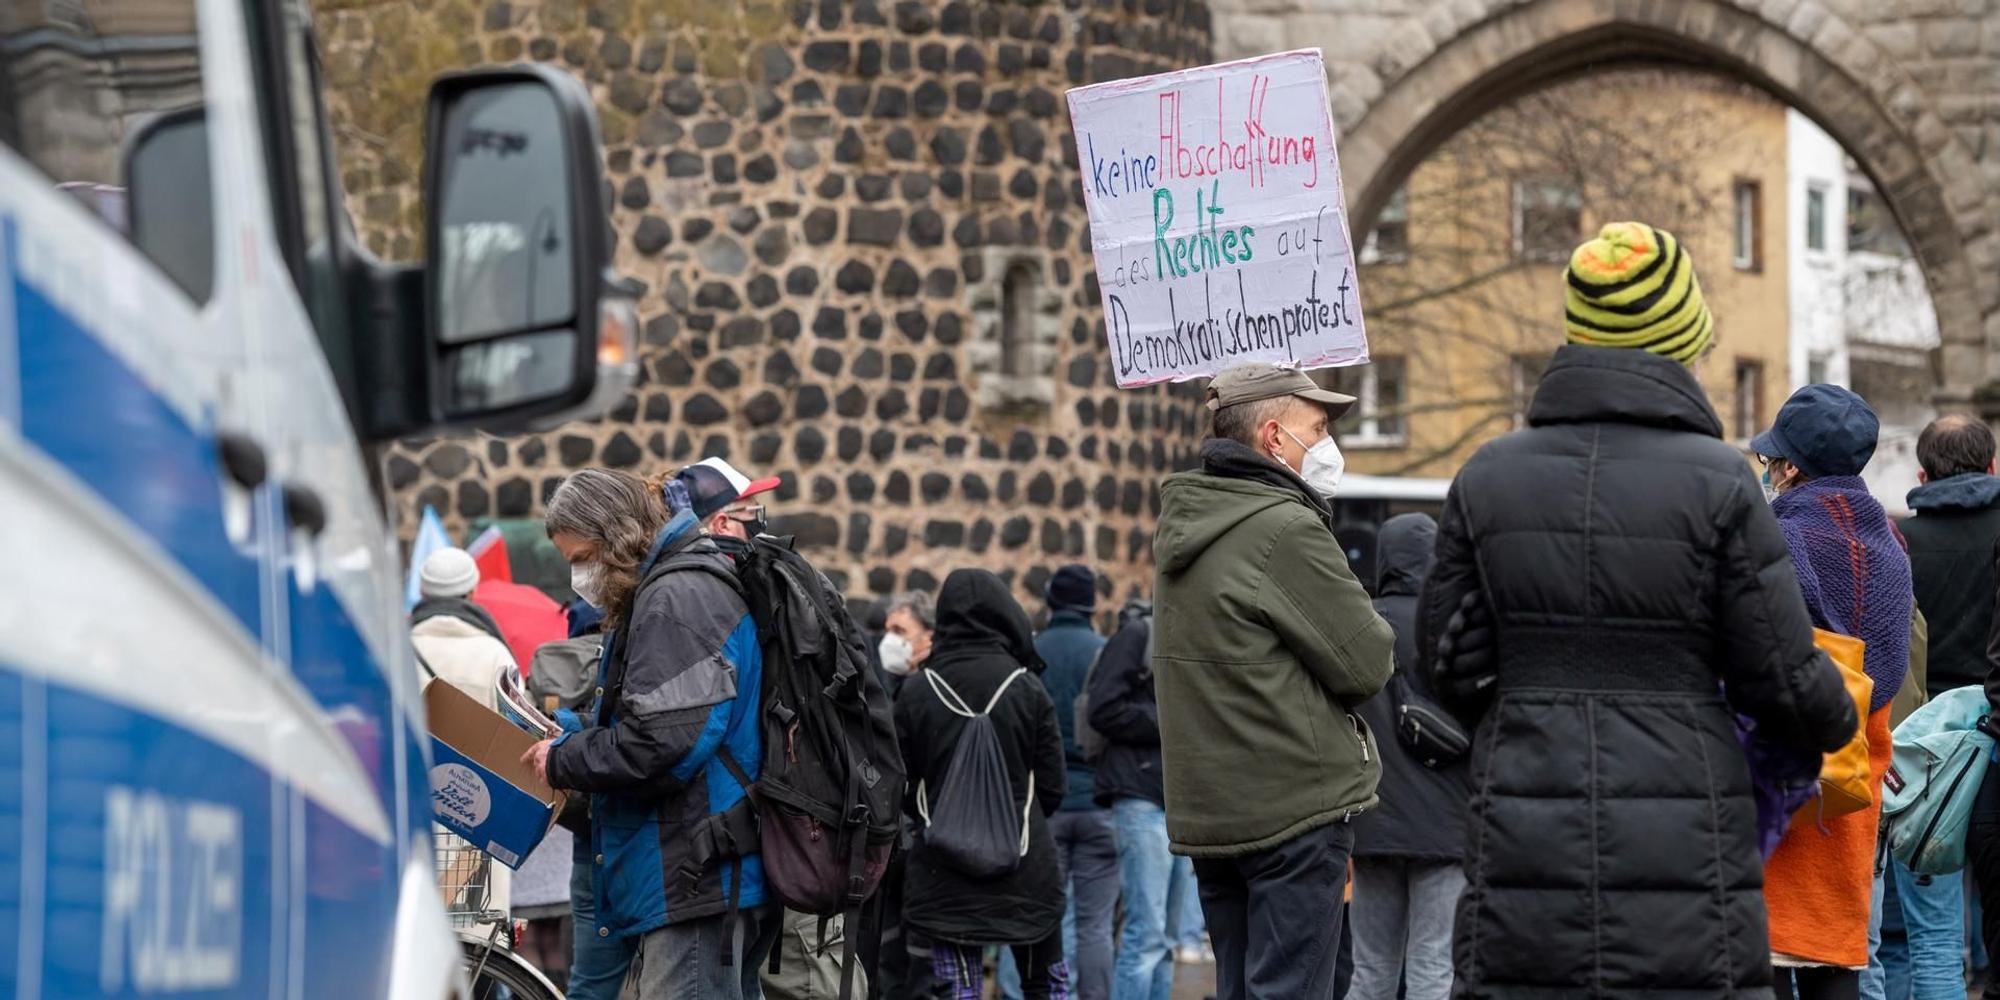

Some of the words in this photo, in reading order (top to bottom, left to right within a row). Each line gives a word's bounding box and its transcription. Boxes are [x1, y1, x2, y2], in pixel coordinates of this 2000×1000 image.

[1088, 132, 1158, 198] keine
[1159, 74, 1317, 188] Abschaffung
[1115, 243, 1150, 288] des
[1153, 178, 1256, 281] Rechtes
[1277, 204, 1327, 265] auf
